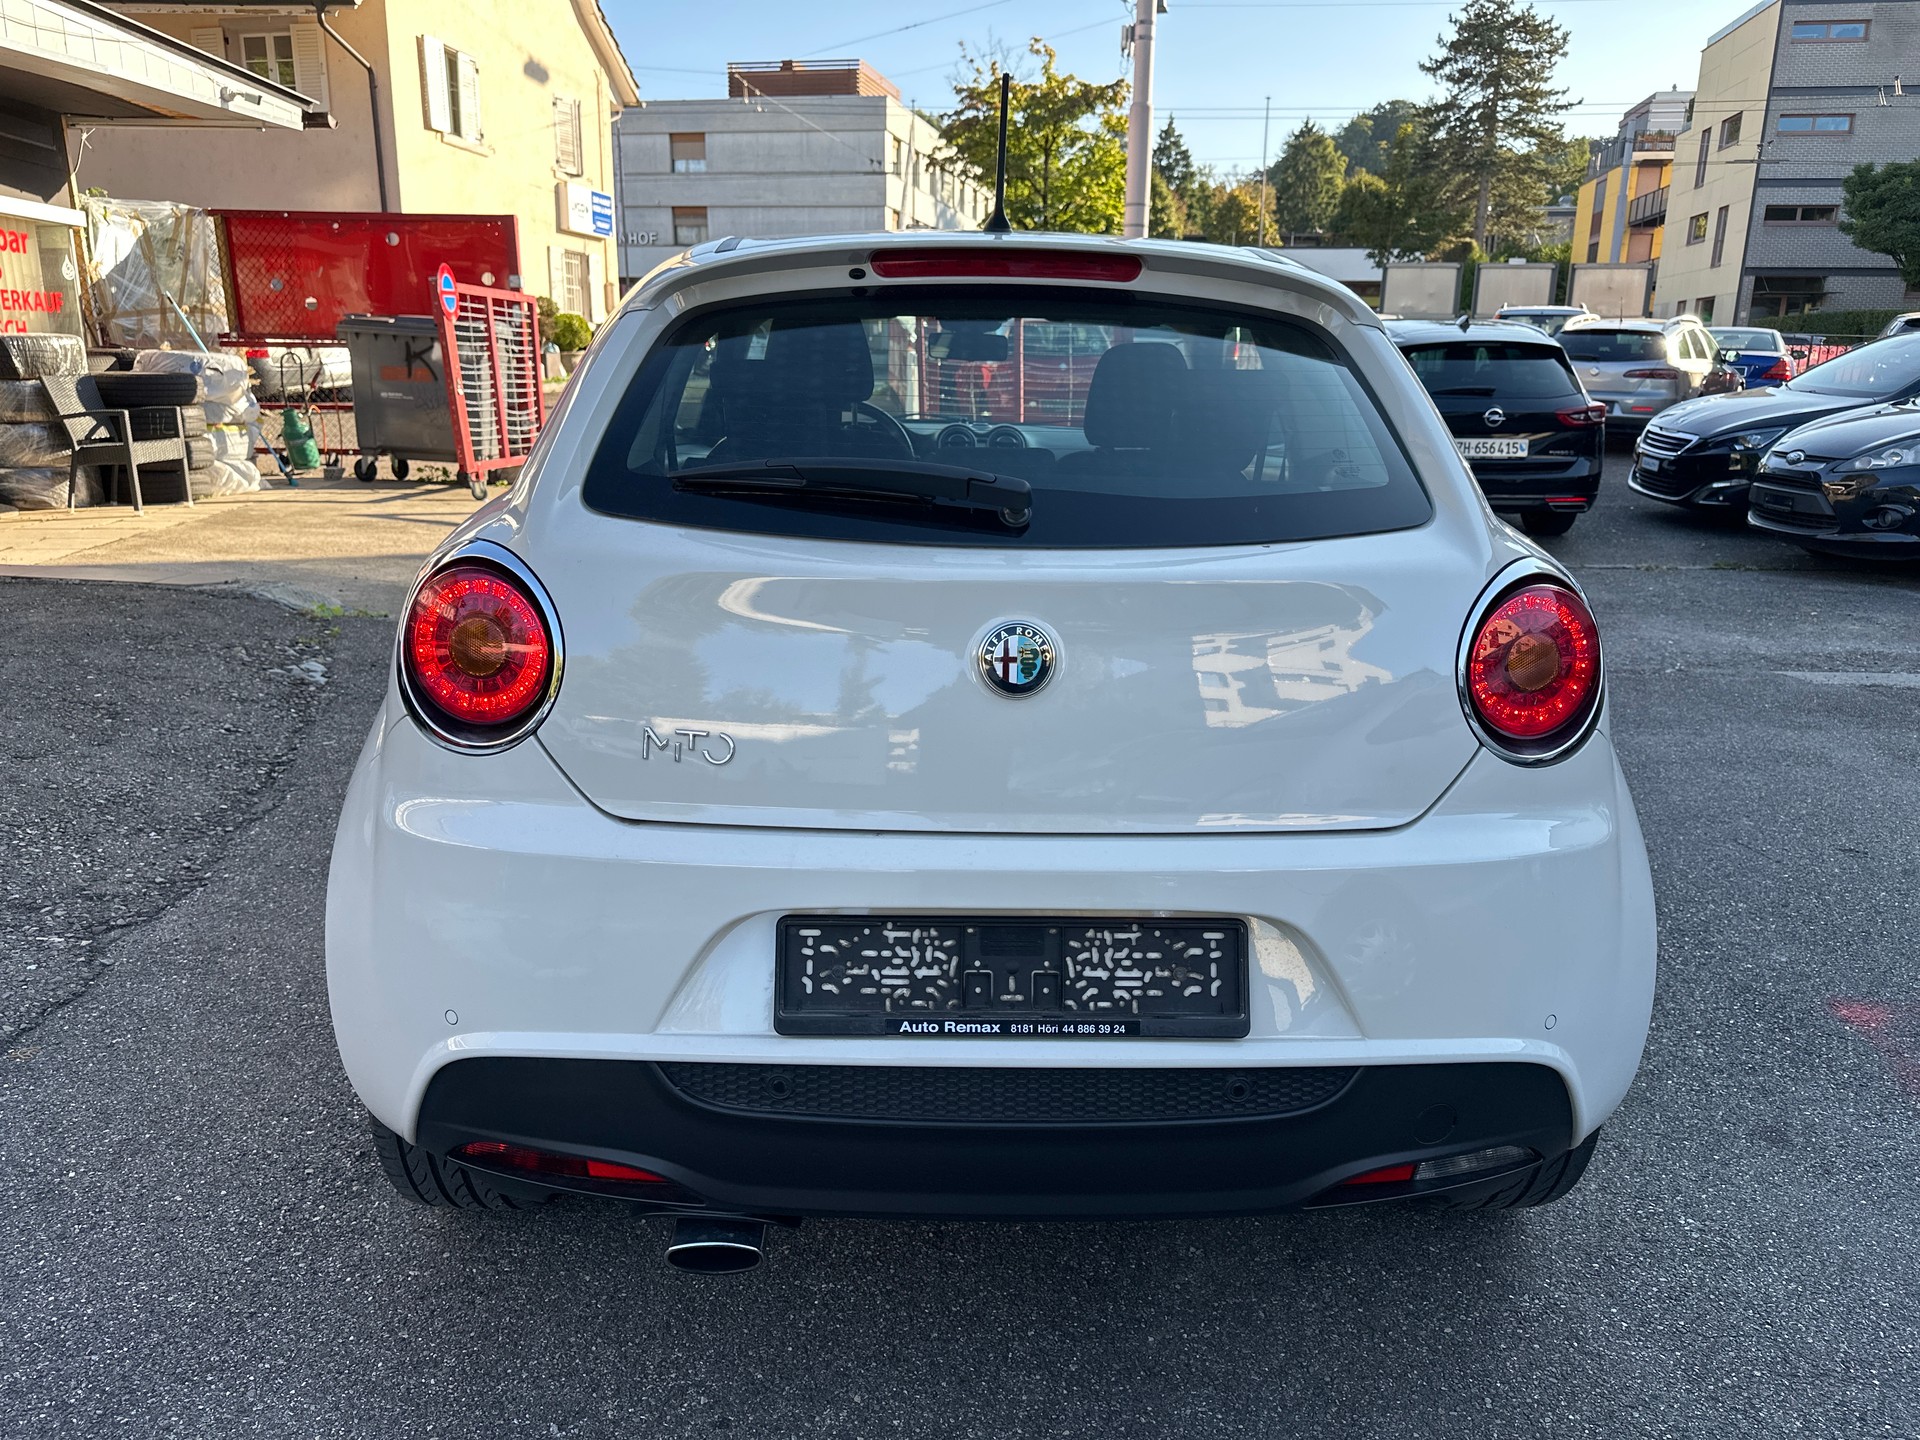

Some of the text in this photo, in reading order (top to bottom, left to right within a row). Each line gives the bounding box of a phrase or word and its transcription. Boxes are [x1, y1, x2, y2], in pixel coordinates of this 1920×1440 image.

[985, 626, 1051, 662] ALFA ROMEO
[900, 1021, 1126, 1034] Auto Remax 8181 Höri 44 886 39 24
